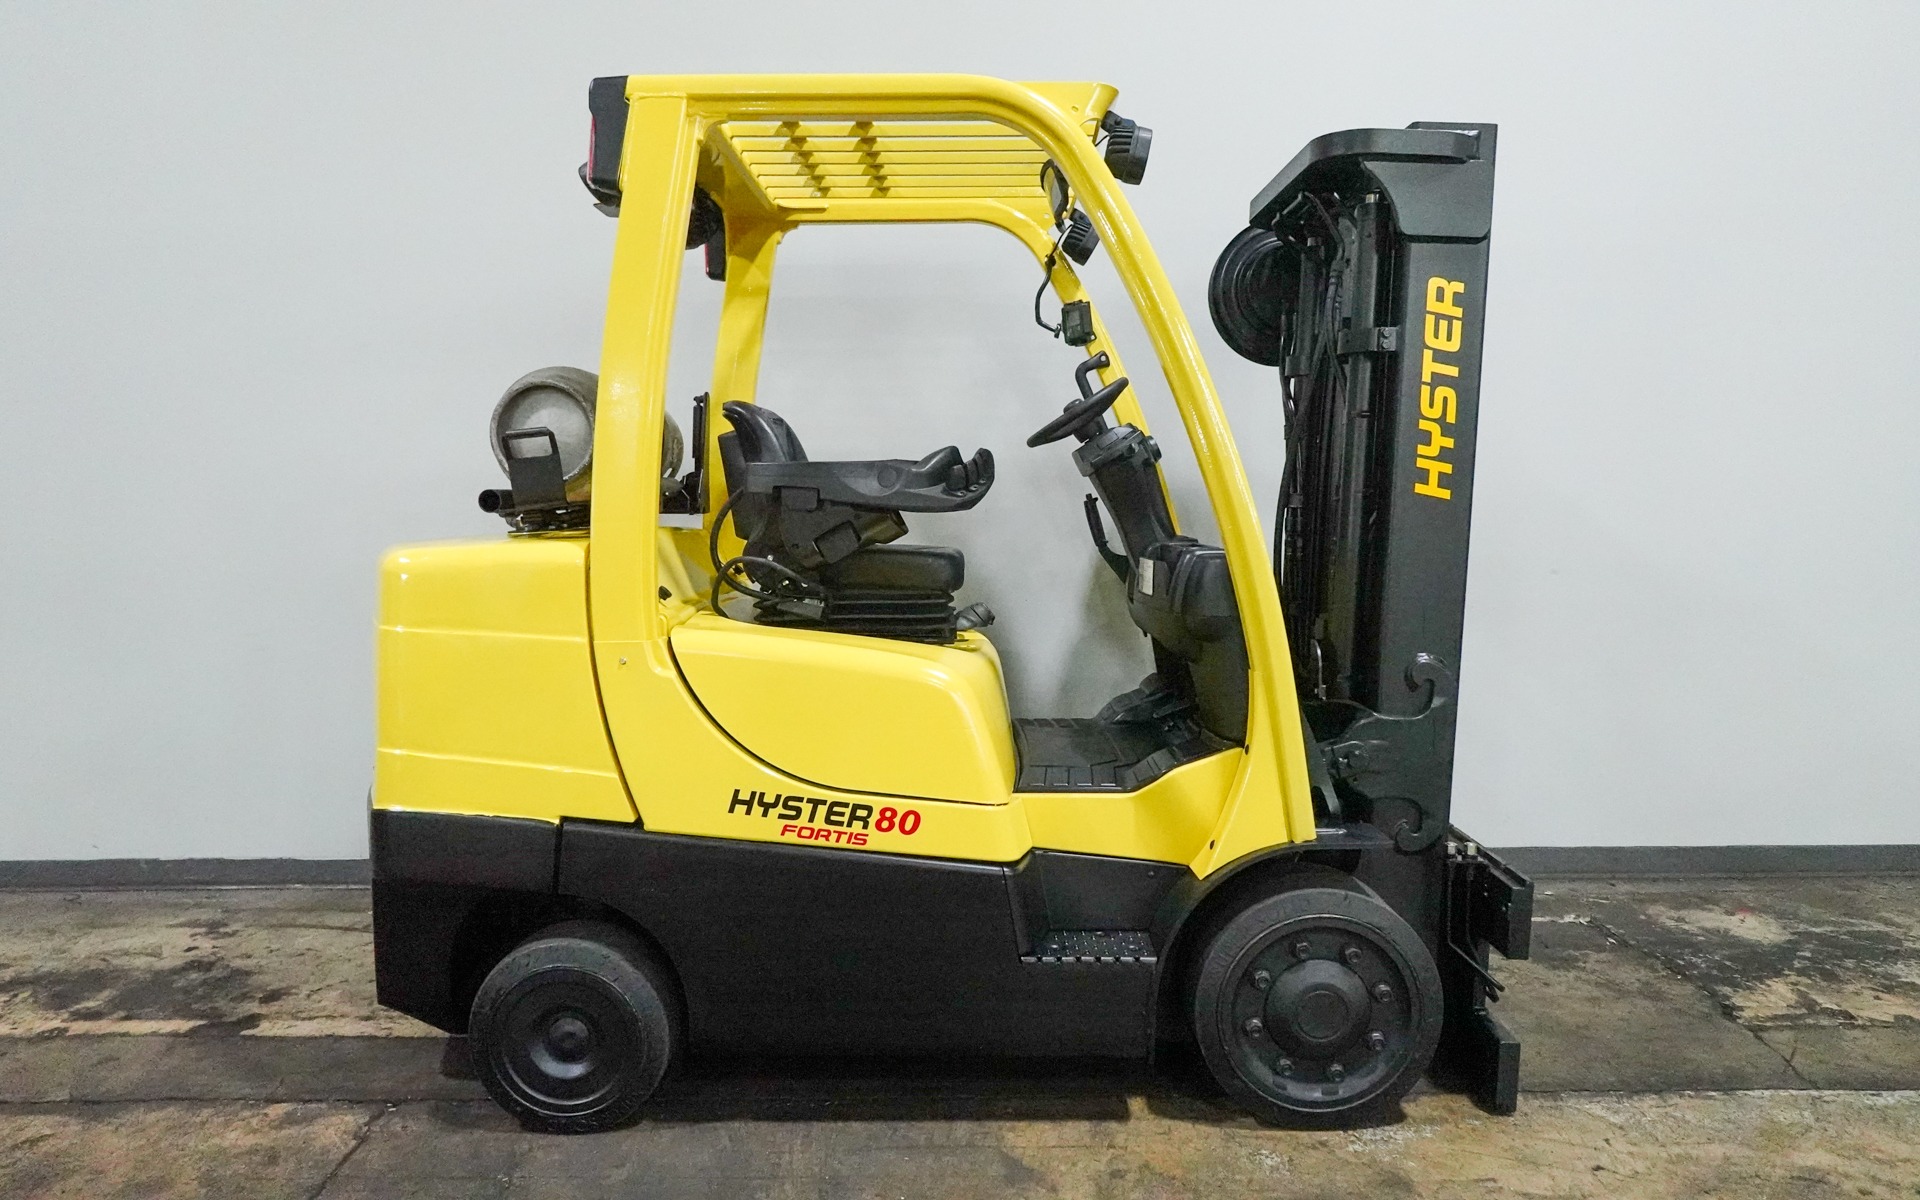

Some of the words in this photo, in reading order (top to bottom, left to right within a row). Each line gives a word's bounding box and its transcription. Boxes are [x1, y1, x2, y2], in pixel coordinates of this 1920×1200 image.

[1414, 276, 1465, 500] HYSTER
[728, 788, 873, 830] HYSTER
[875, 806, 921, 836] 80
[780, 824, 869, 846] FORTIS
